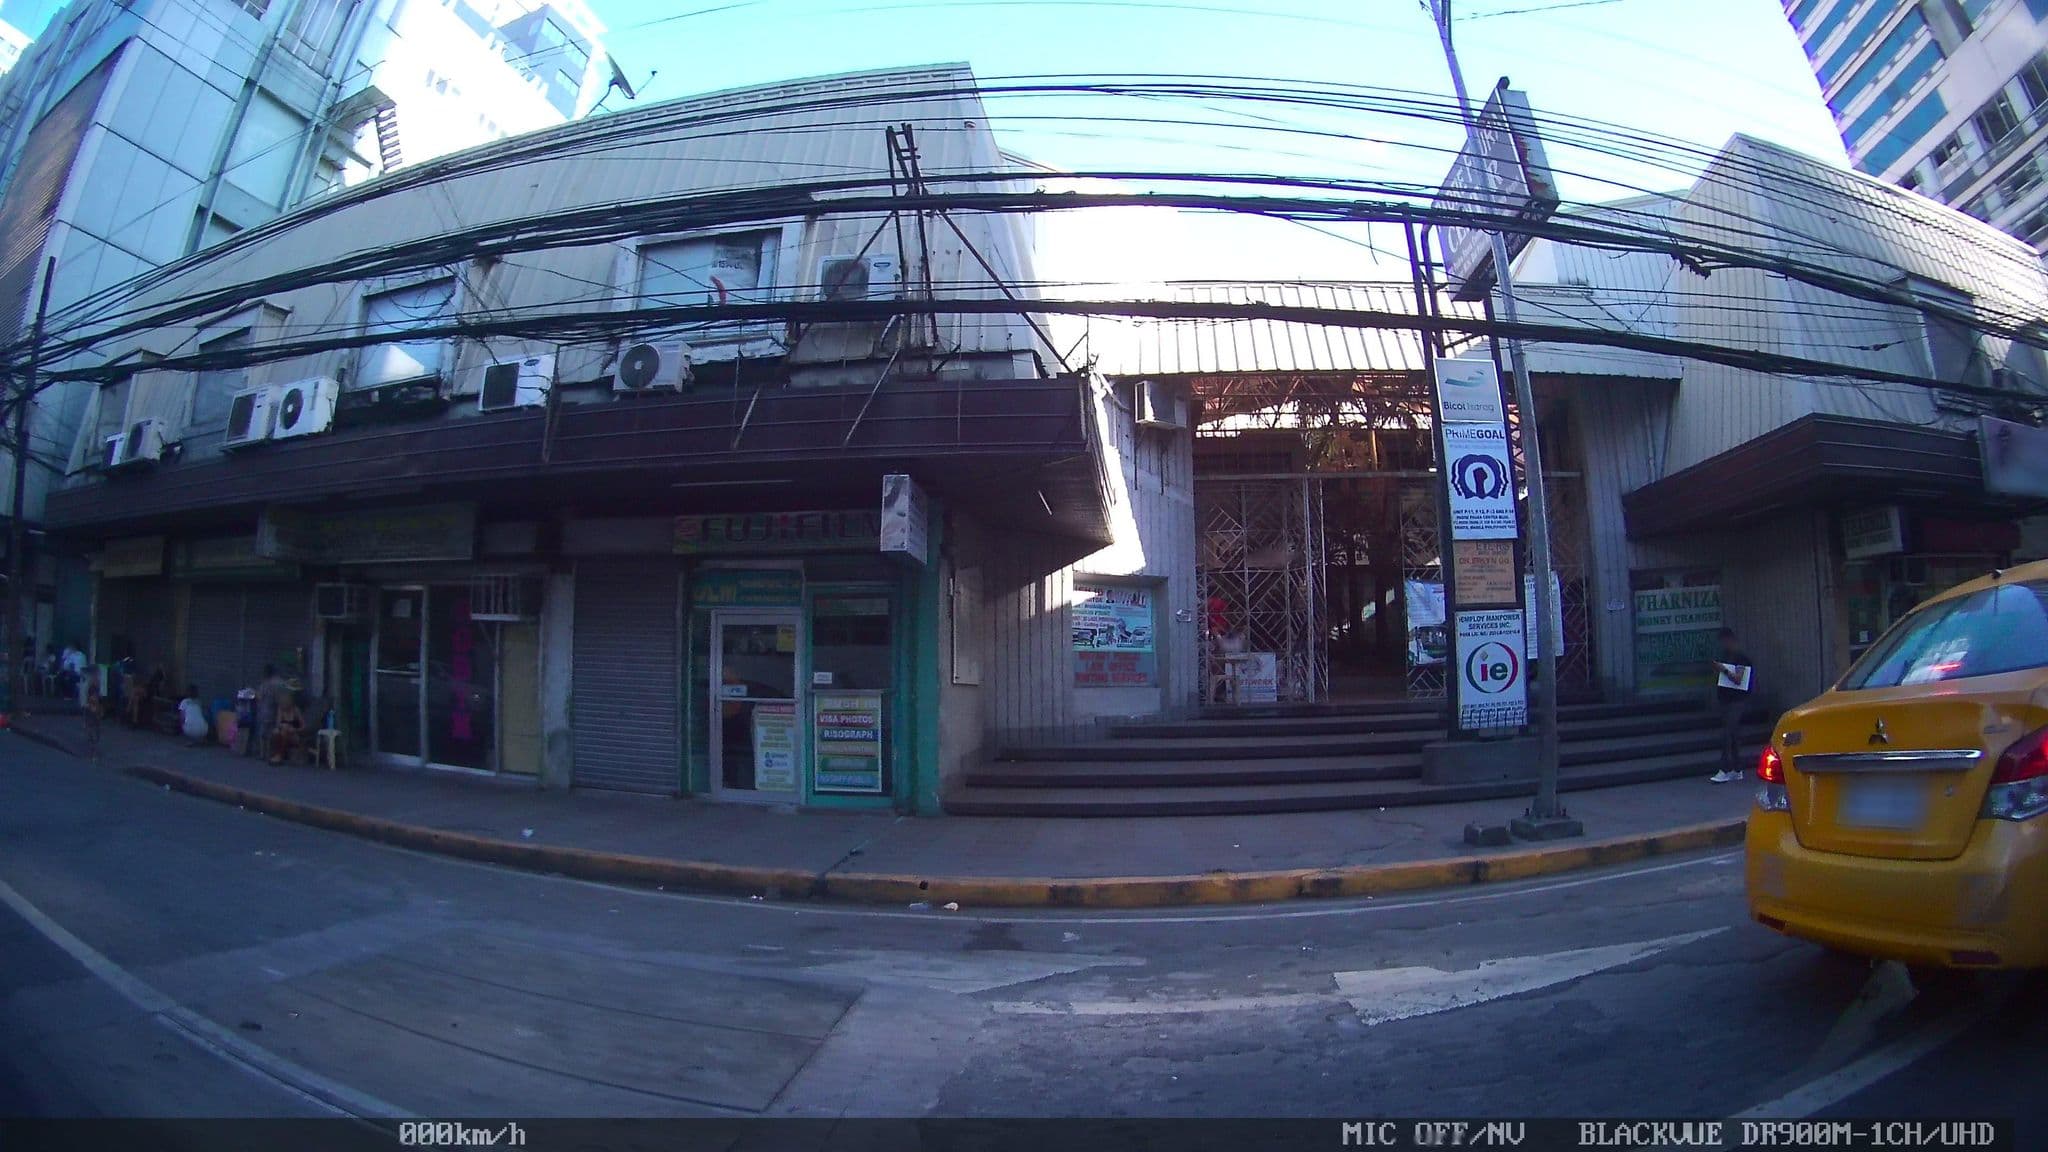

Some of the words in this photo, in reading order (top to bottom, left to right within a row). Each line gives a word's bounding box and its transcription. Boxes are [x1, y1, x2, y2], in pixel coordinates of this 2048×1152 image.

[1637, 615, 1672, 626] MONEY
[820, 714, 839, 724] VISA
[840, 714, 874, 724] PHOTOS
[823, 730, 874, 739] RISOGRAPH
